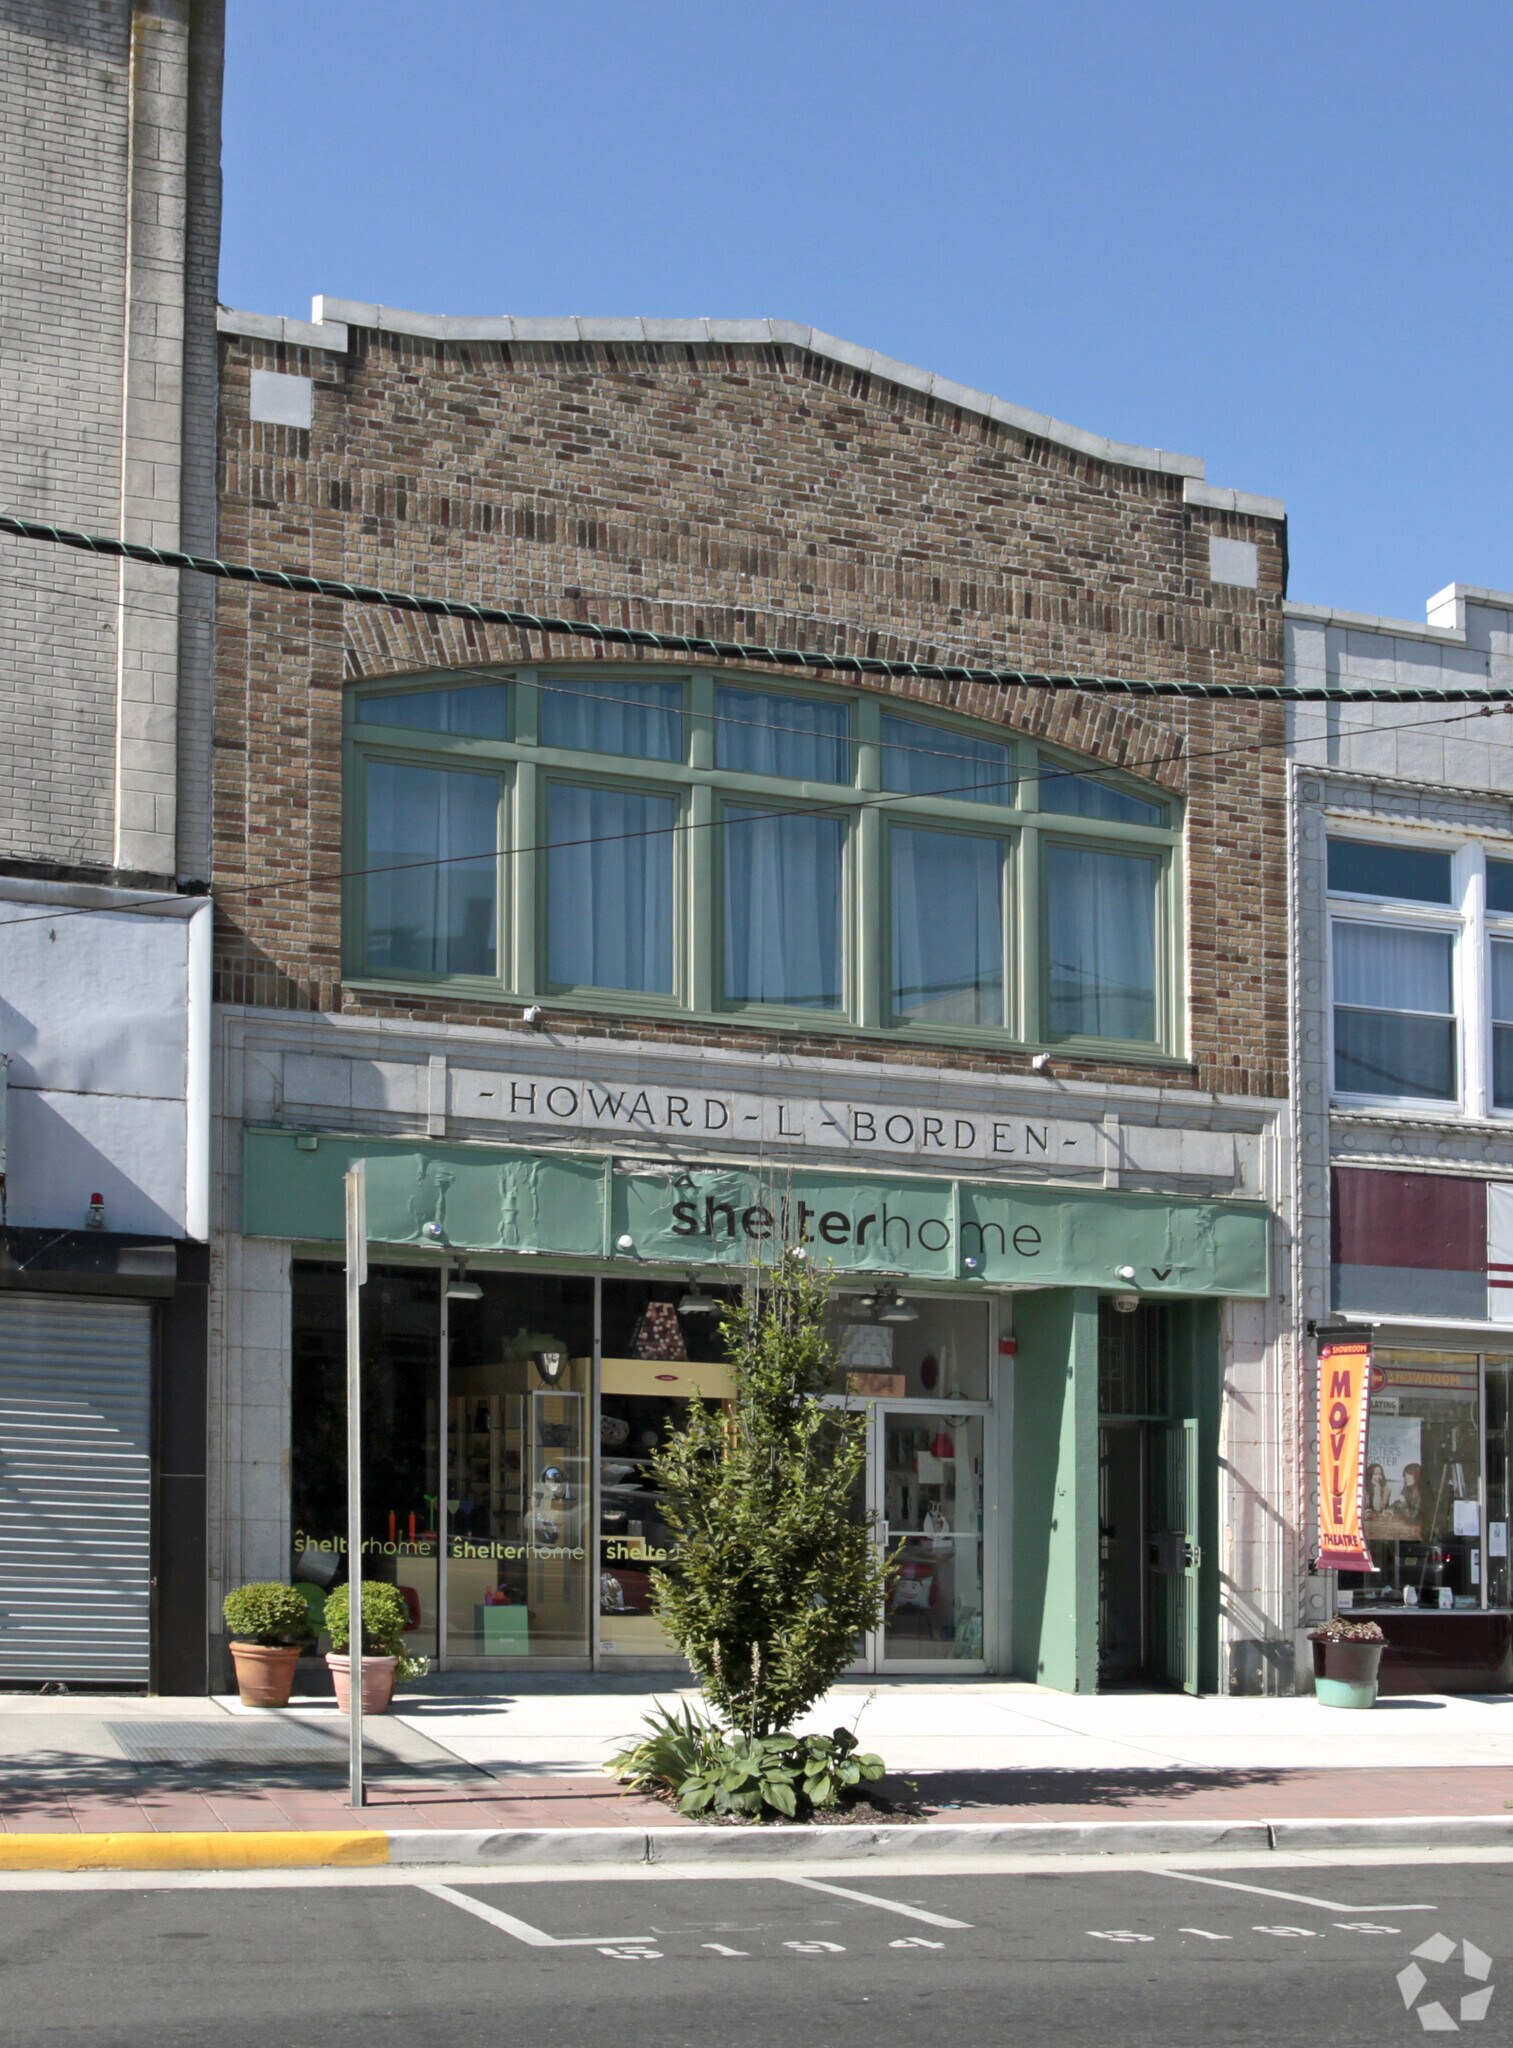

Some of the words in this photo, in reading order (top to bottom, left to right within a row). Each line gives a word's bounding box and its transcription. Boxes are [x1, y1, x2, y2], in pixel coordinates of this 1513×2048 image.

[1329, 1370, 1351, 1525] MOVIE
[294, 1535, 431, 1555] sheltrhome
[1323, 1533, 1359, 1548] THEATRE
